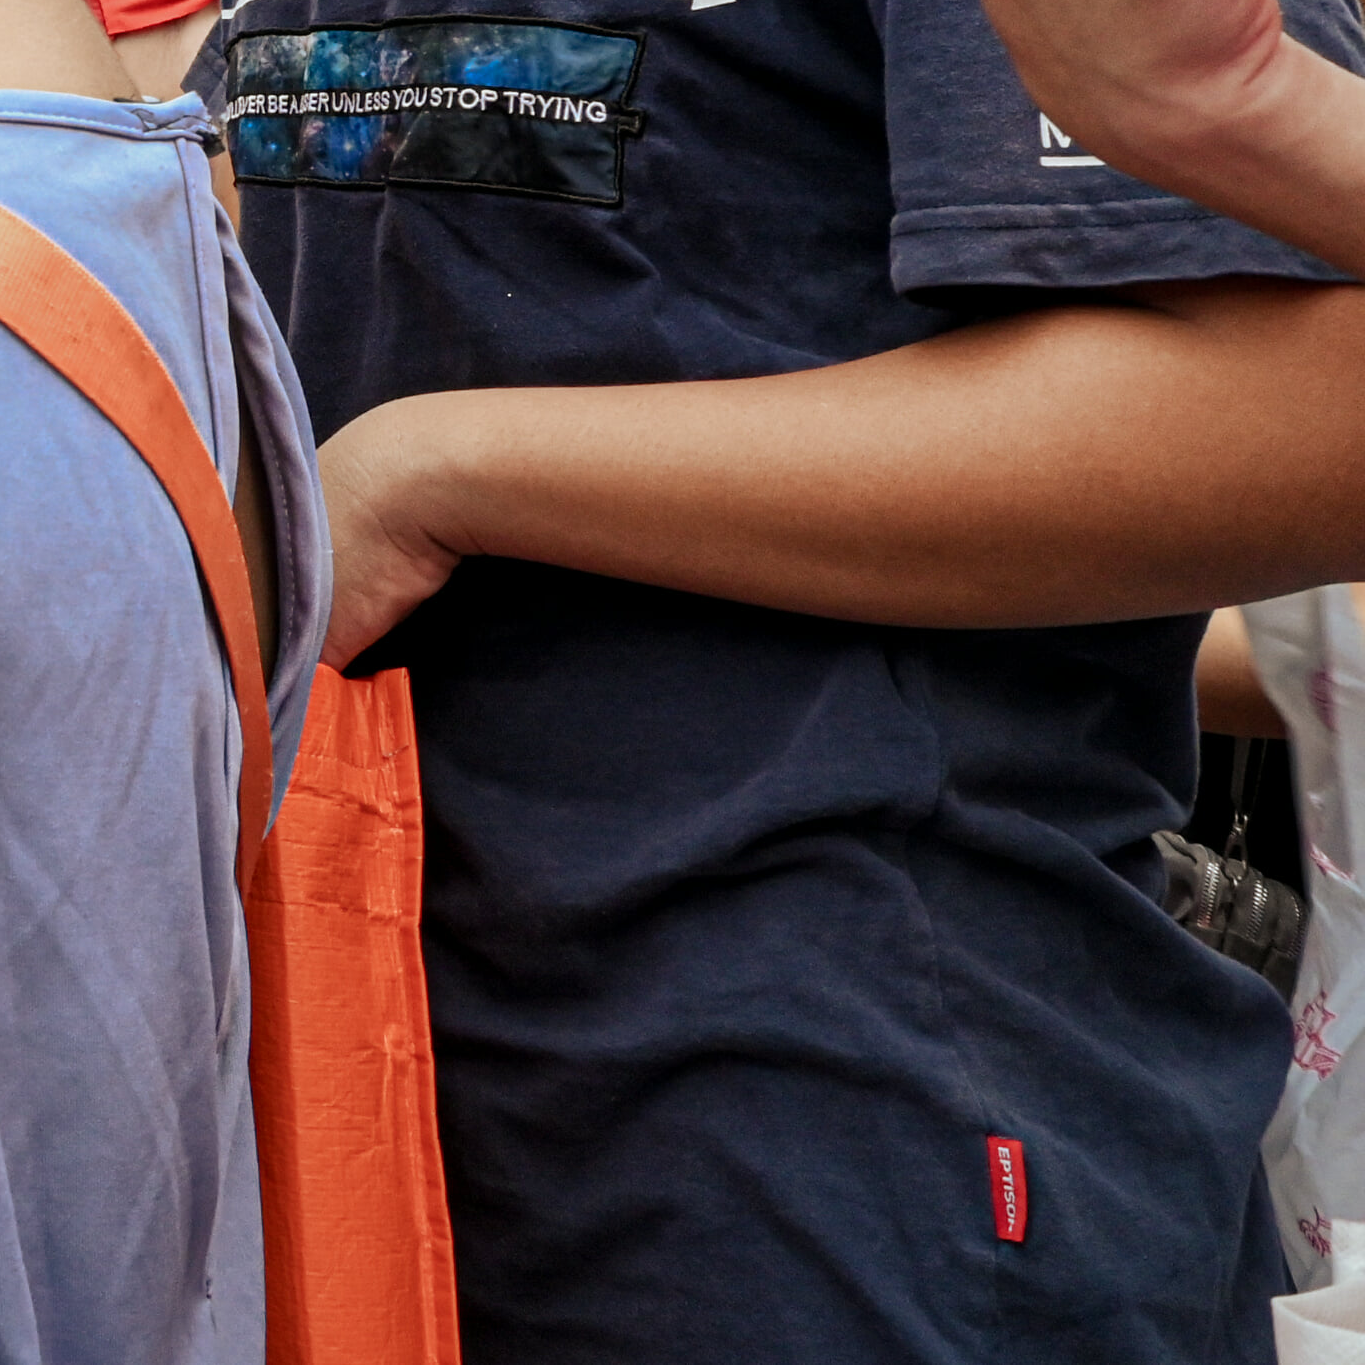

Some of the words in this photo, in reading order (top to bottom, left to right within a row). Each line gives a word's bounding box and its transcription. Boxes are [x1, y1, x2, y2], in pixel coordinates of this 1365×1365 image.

[267, 94, 289, 114] BE
[332, 89, 390, 114] UNLESS
[392, 86, 428, 110] YOU
[429, 86, 499, 111] STOP
[503, 90, 608, 123] TRYING
